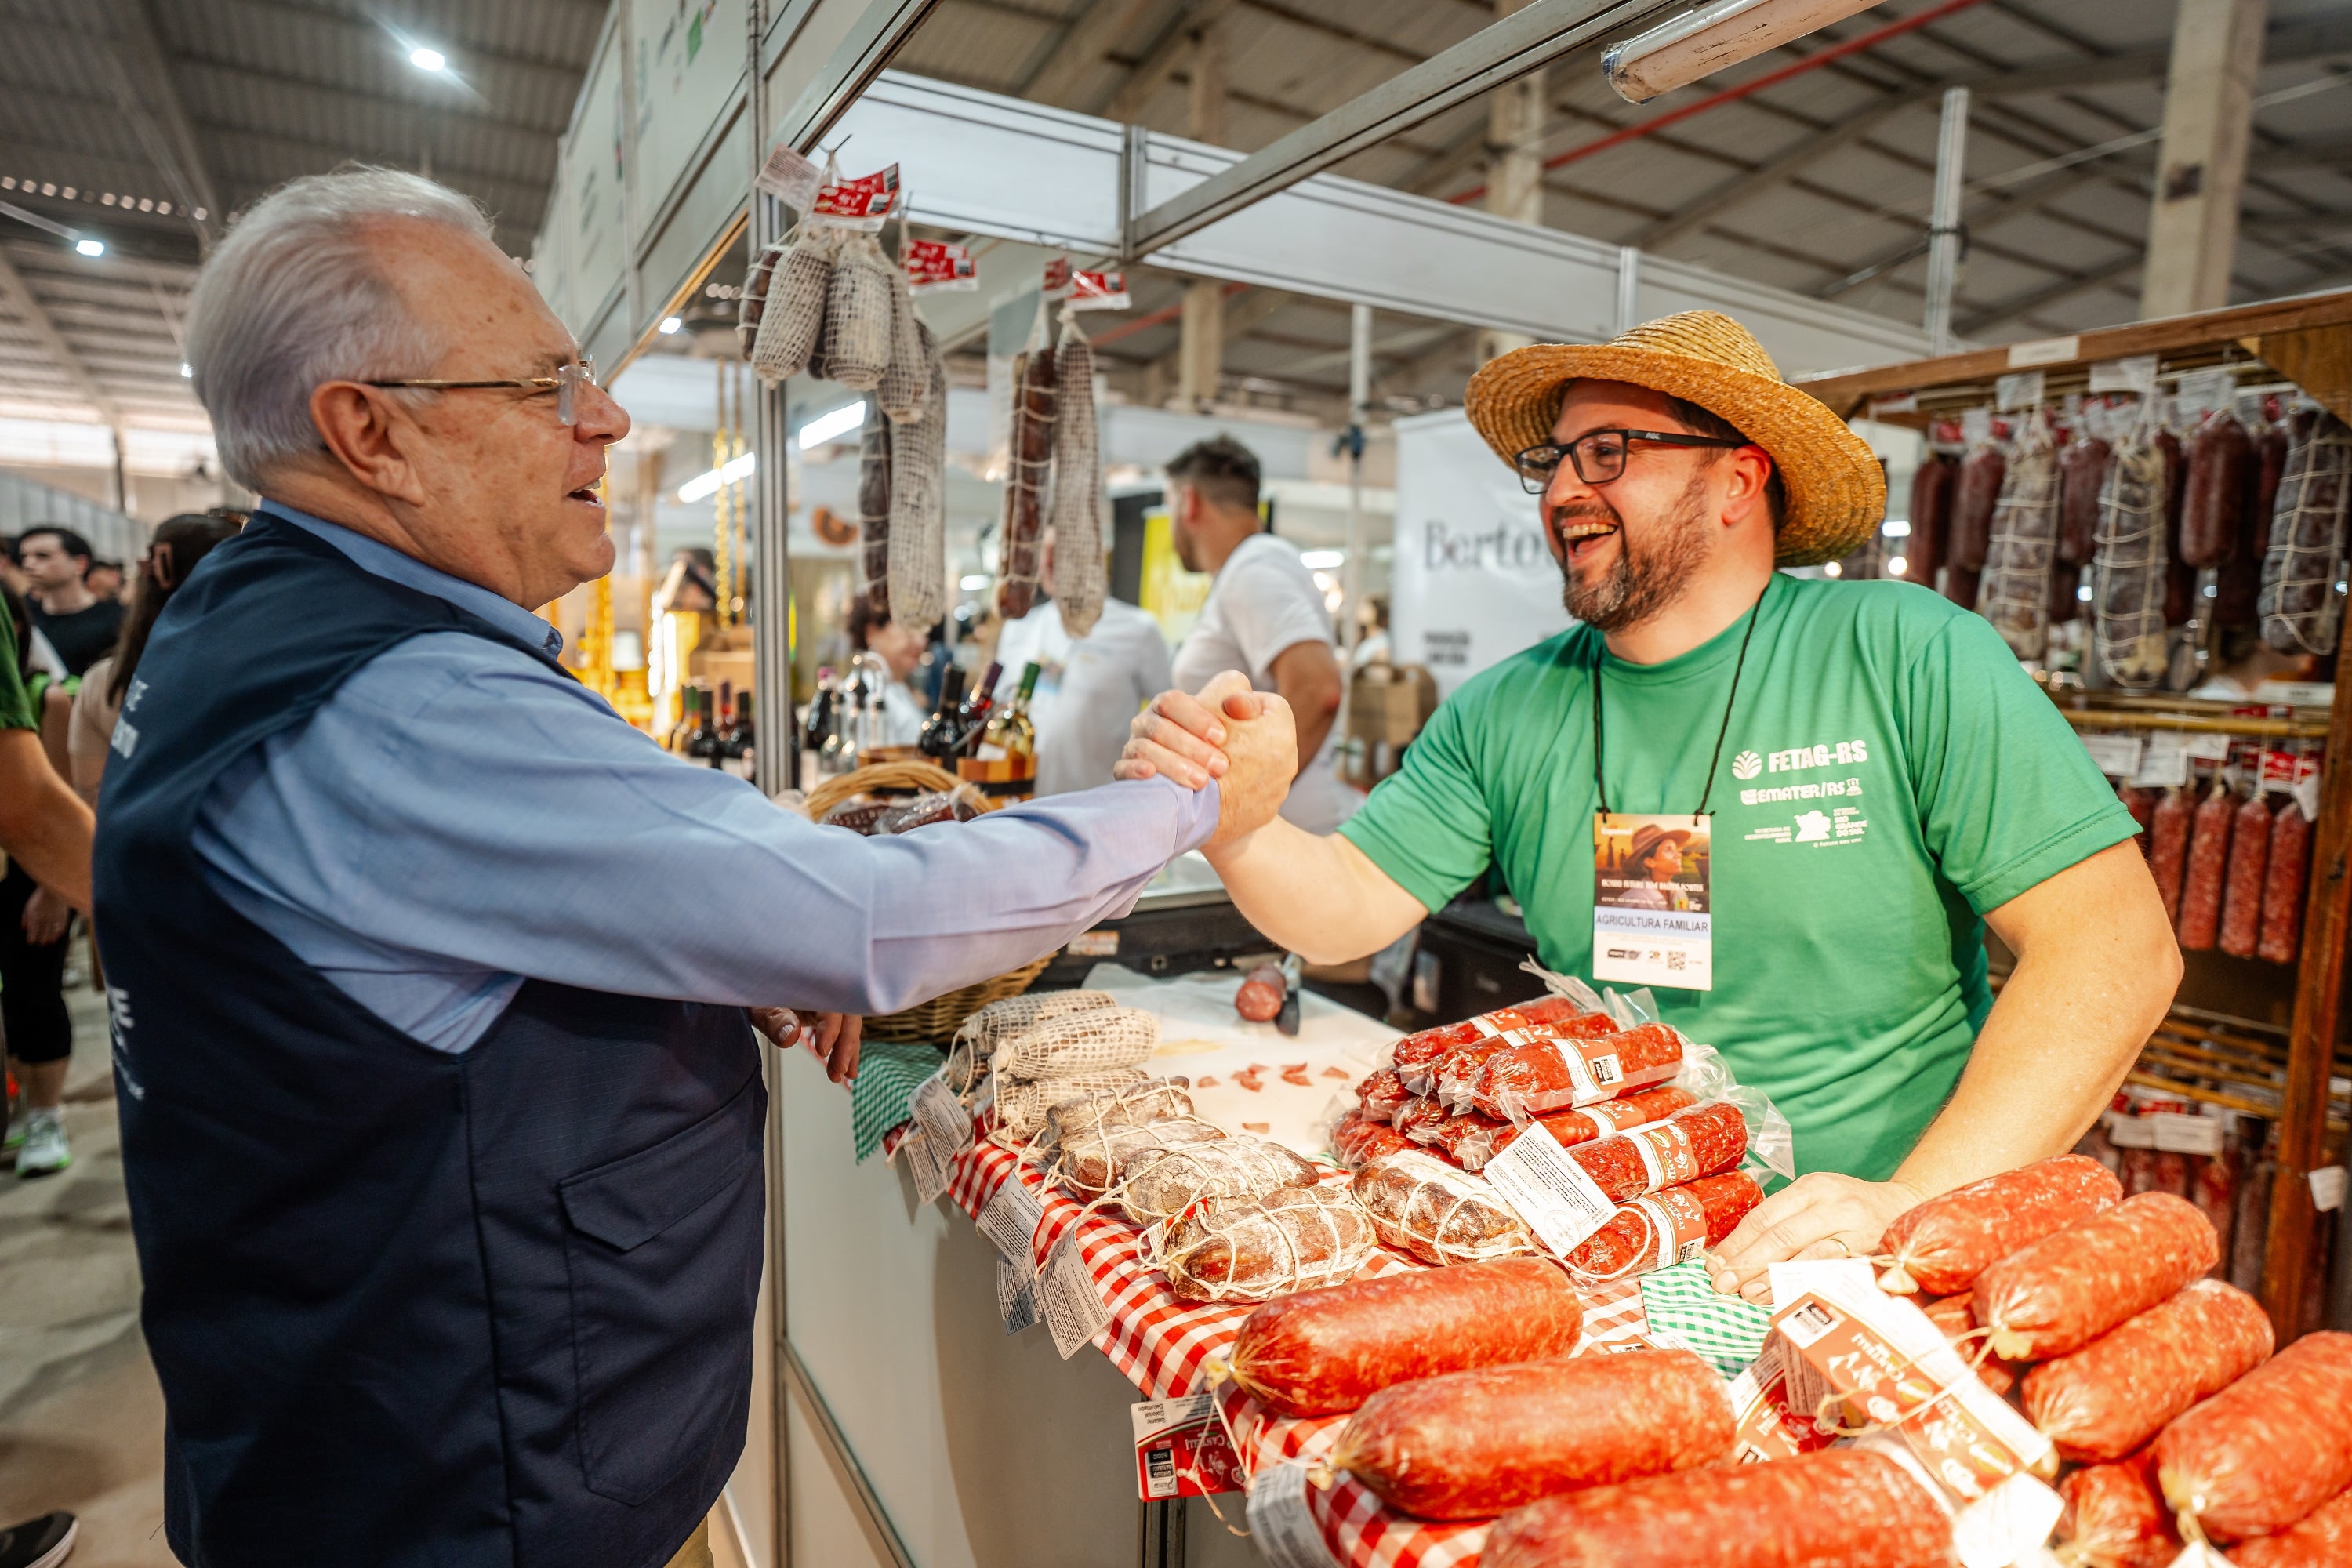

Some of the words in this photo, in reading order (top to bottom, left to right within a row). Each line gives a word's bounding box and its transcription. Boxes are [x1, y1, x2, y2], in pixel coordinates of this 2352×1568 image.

[1424, 522, 1555, 571] Berto
[1769, 740, 1867, 772] FETAG-RS
[1758, 782, 1845, 803] EMATER/RS
[1596, 914, 1661, 928] AGRICULTURA
[1664, 919, 1708, 932] FAMILIAR
[1138, 1403, 1163, 1412] Defumado
